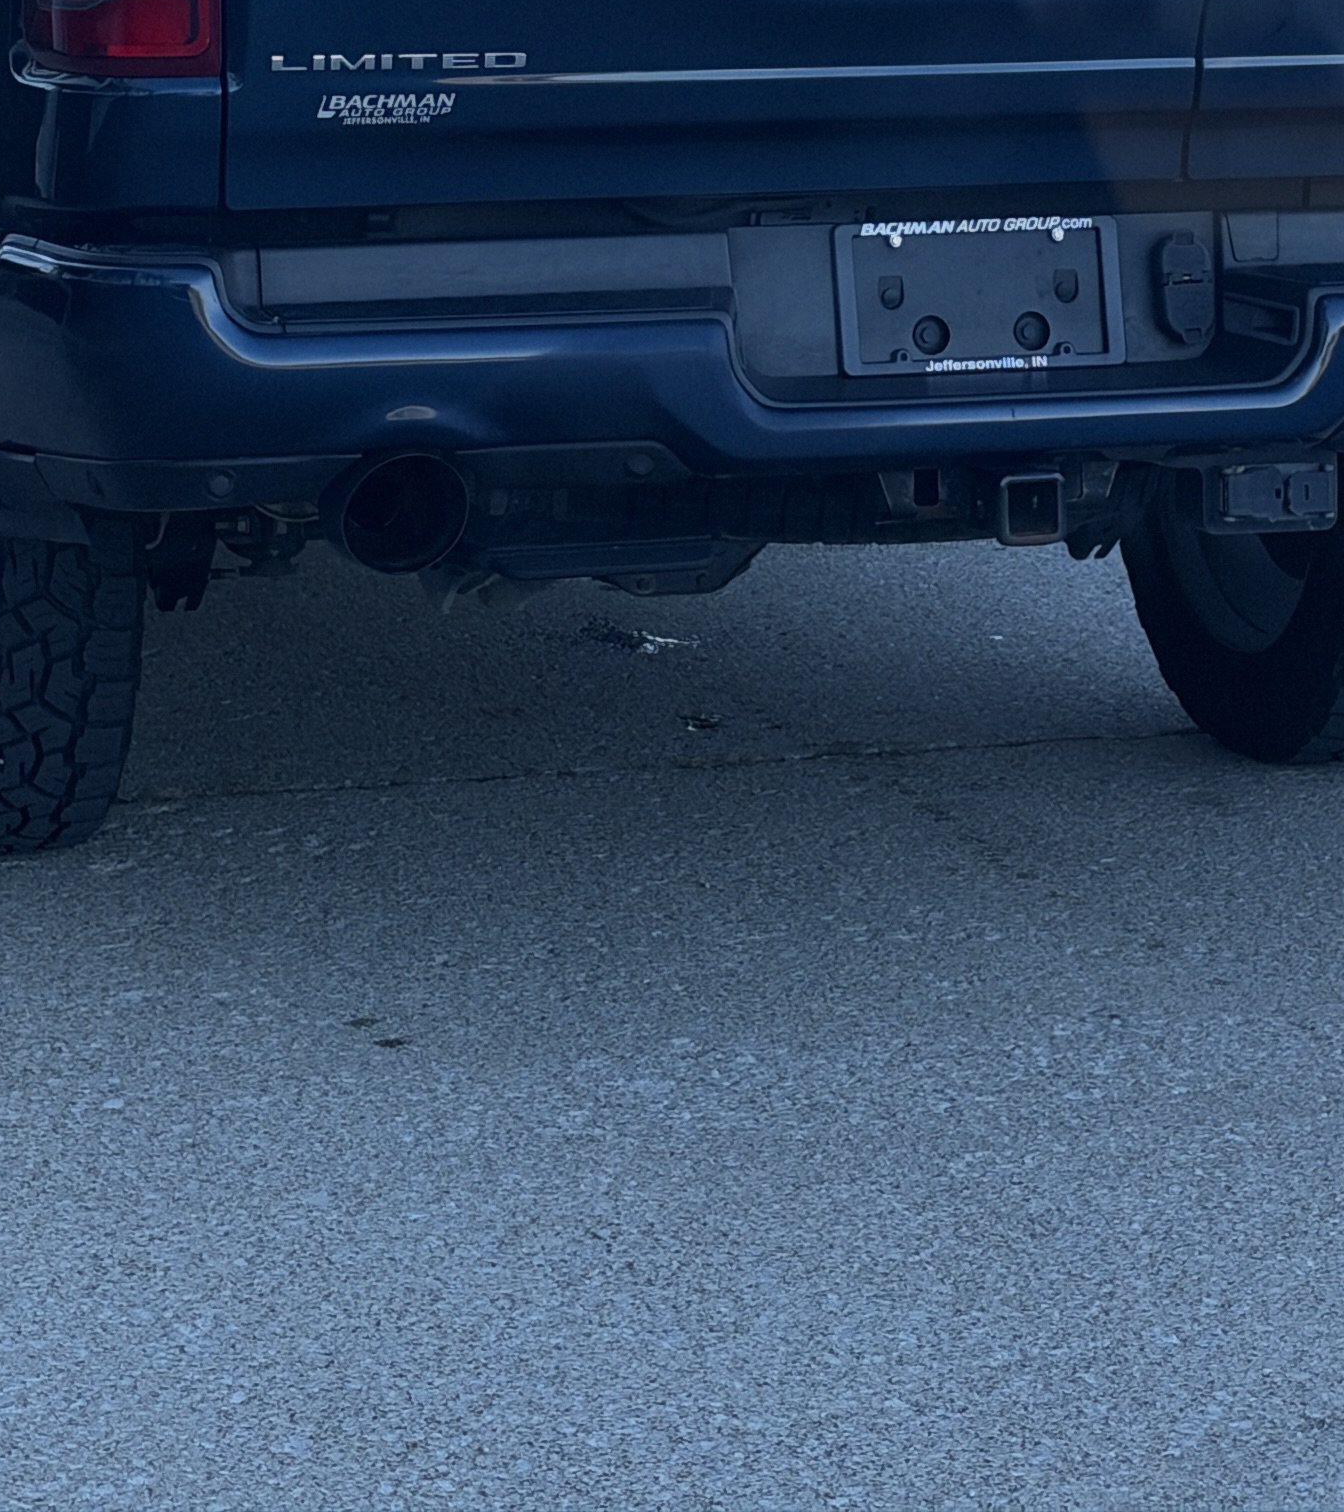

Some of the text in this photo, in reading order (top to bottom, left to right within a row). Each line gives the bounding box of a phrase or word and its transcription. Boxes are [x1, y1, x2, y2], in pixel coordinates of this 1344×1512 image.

[271, 51, 528, 72] LIMITED
[328, 92, 456, 110] BACHMAN
[338, 106, 452, 118] AUTO GROUP
[419, 115, 431, 124] IN
[859, 219, 955, 237] BACHMAN
[956, 218, 1001, 234] AUTO
[925, 355, 1049, 373] Jeffersonville, IN
